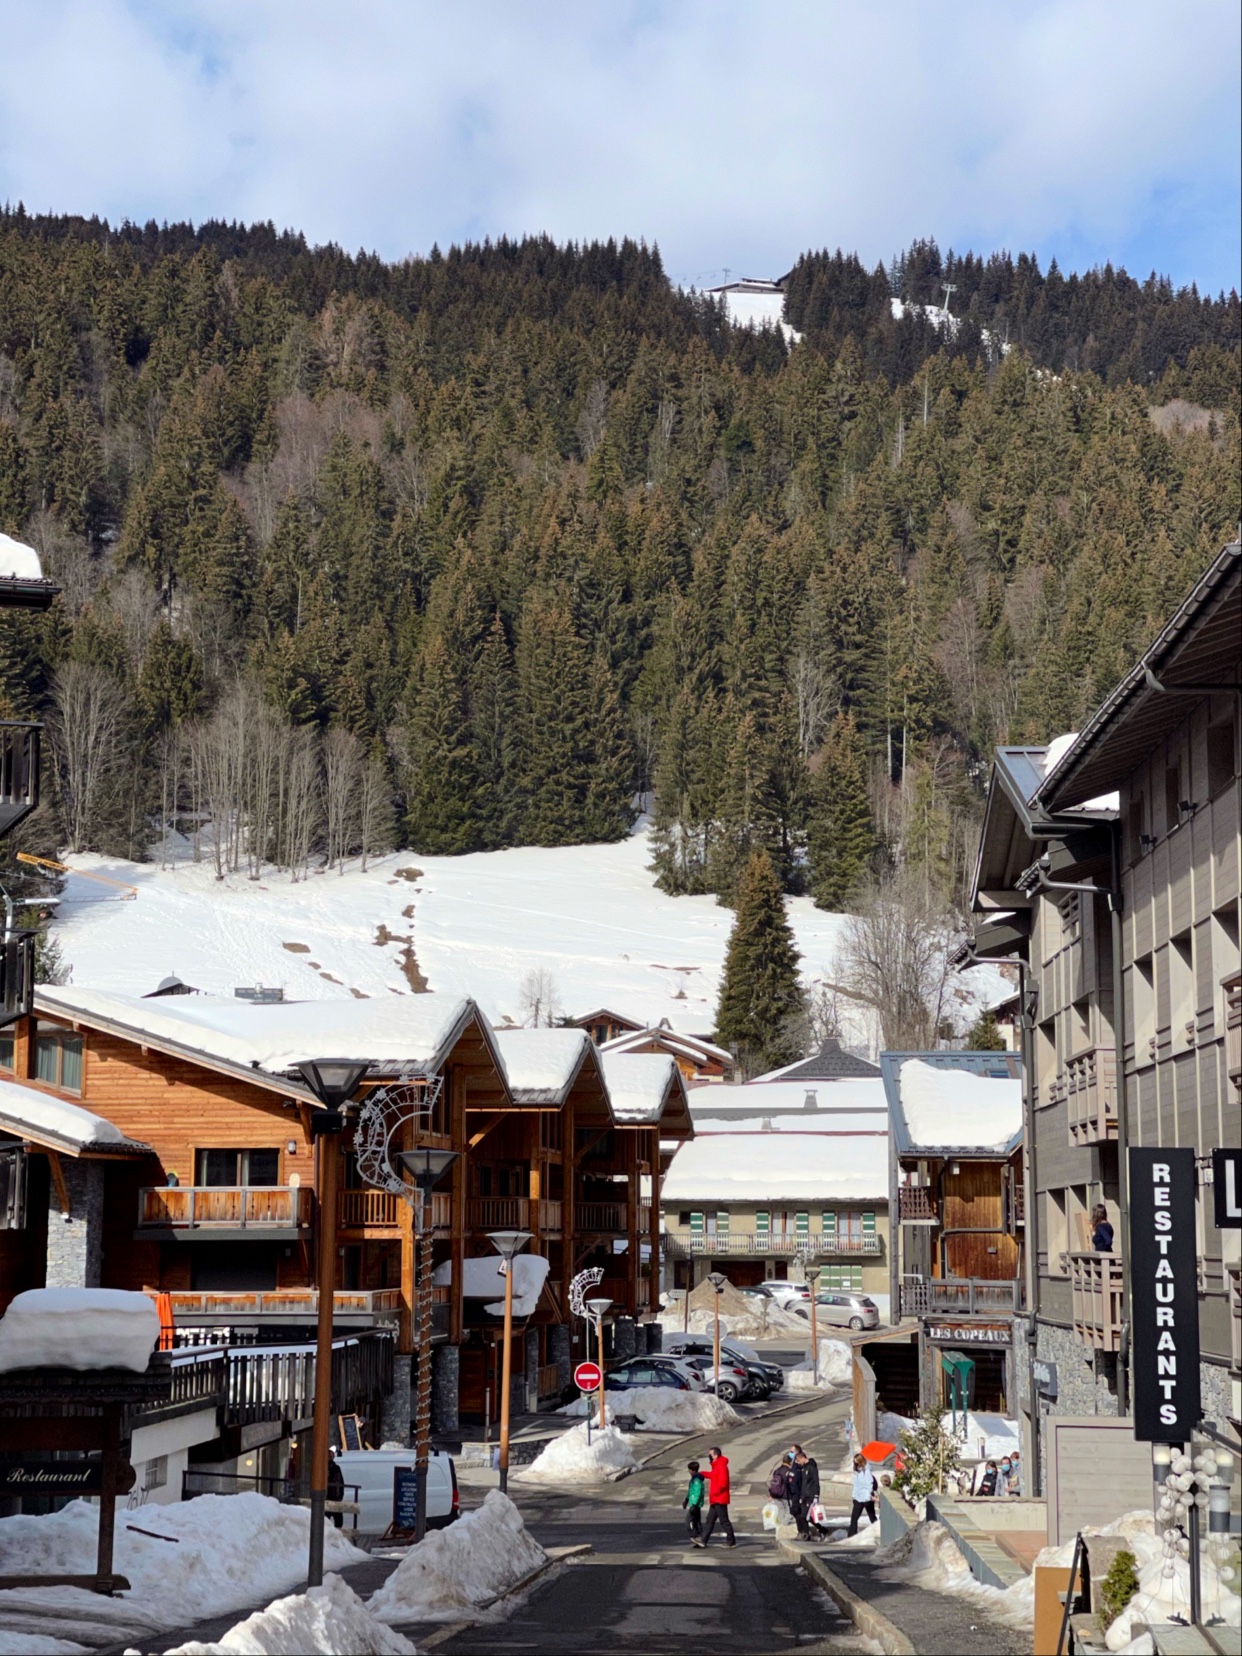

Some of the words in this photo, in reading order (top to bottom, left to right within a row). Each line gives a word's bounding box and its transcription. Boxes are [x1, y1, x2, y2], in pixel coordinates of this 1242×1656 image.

[1152, 1163, 1177, 1425] RESTAURANTS
[930, 1327, 951, 1339] LES
[954, 1329, 1010, 1341] COPEAUX
[6, 1468, 92, 1483] Restaurant
